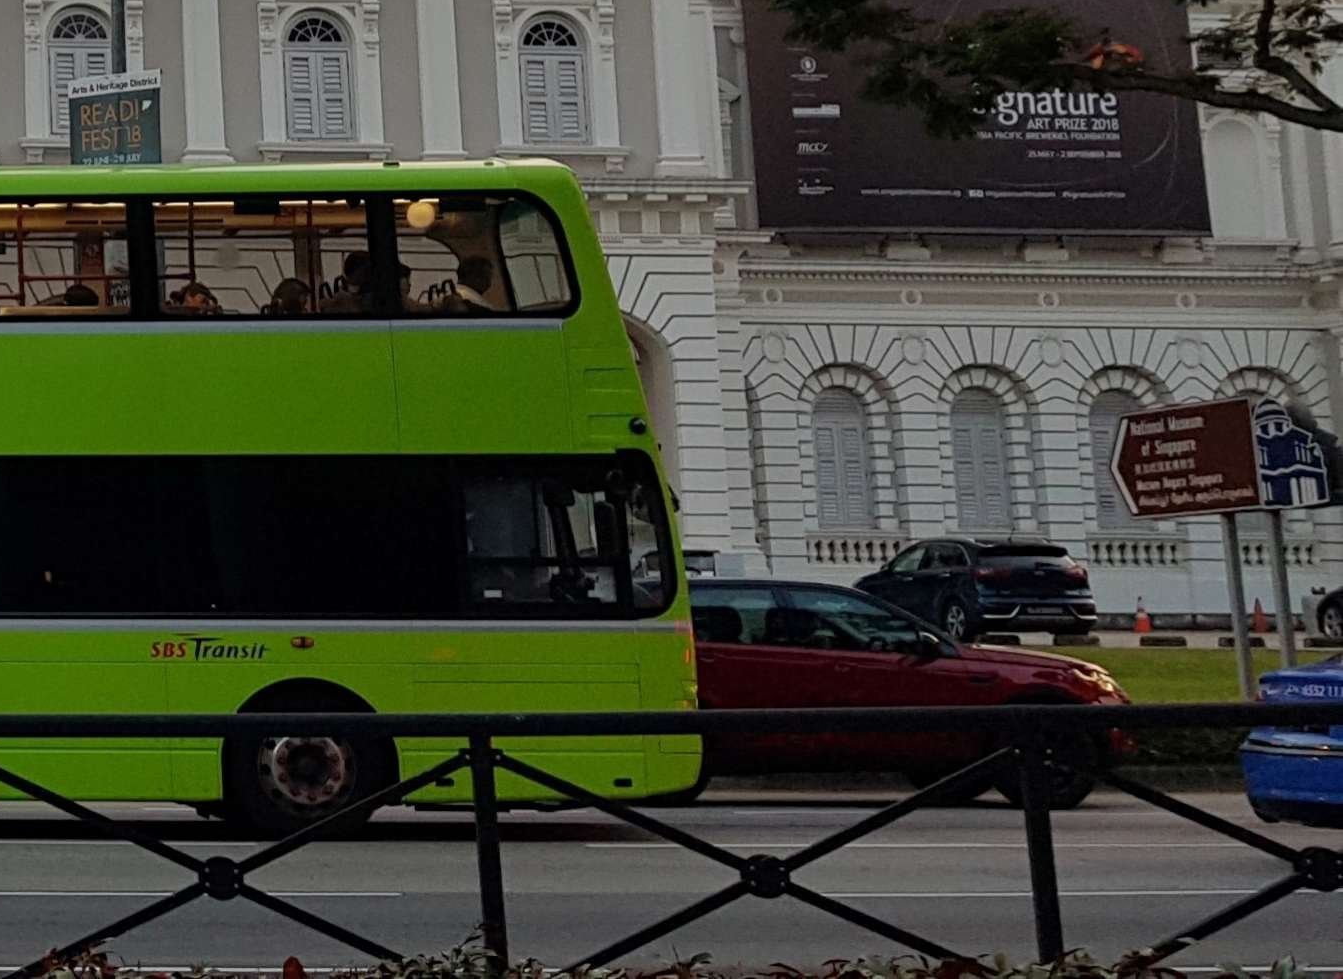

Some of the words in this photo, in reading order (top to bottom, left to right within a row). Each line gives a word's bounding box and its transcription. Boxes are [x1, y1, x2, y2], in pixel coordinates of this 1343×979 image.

[72, 86, 88, 95] Arts
[89, 83, 95, 93] &
[97, 81, 128, 92] Heritage
[130, 77, 157, 87] District
[80, 99, 139, 127] READ!
[972, 83, 1118, 126] gnature
[1026, 117, 1051, 130] ART
[1055, 117, 1088, 131] PRIZE
[1091, 117, 1120, 131] 2018
[81, 126, 122, 152] FEST
[994, 131, 1023, 140] PACIFIC
[1025, 131, 1069, 141] BREWERIES
[1070, 132, 1120, 141] FOUNDATION
[1130, 418, 1165, 436] National
[1167, 416, 1205, 432] Museum
[1141, 441, 1150, 456] of
[1154, 439, 1197, 457] Singapore
[150, 641, 187, 658] SBS
[185, 637, 271, 660] Transit
